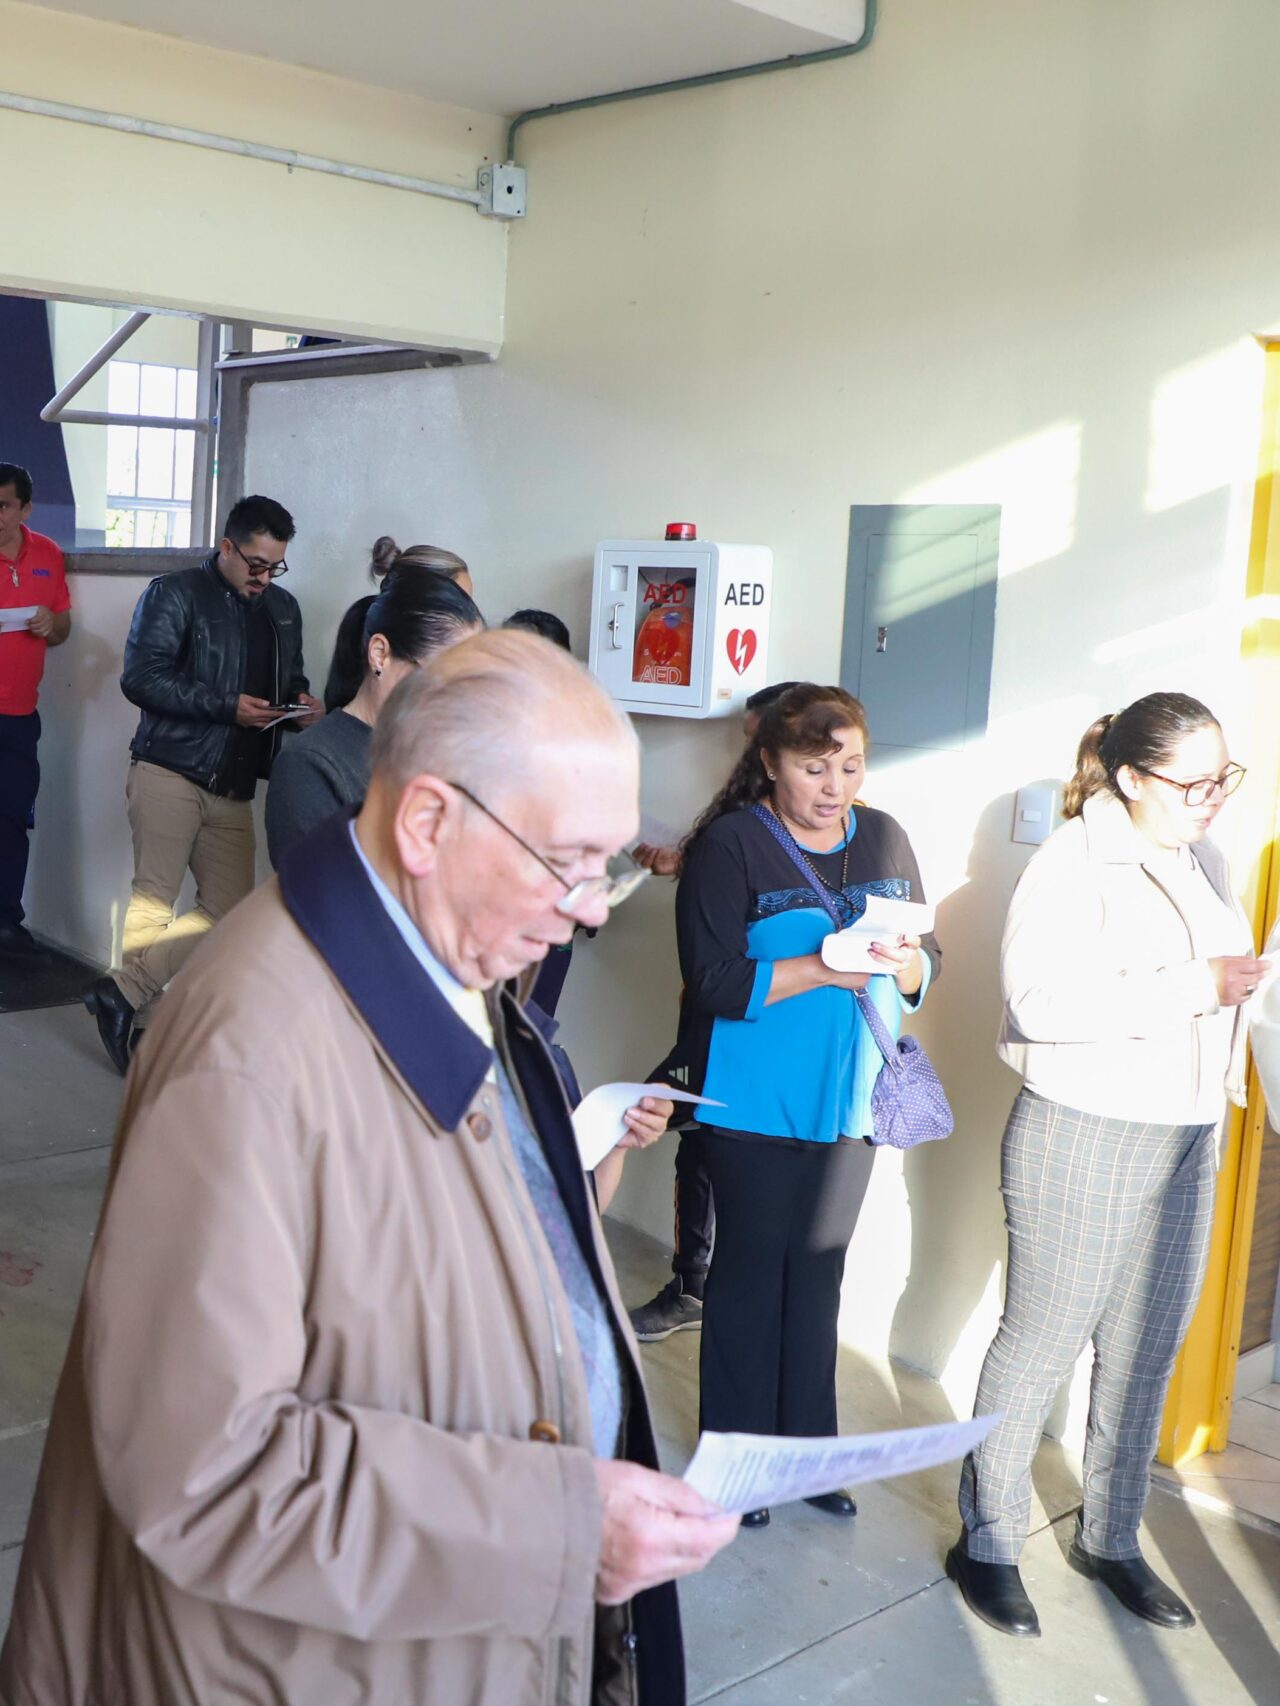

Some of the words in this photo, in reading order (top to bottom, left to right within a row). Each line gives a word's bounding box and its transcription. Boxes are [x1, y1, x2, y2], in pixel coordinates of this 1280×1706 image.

[643, 583, 687, 604] AED
[724, 583, 765, 606] AED
[639, 664, 682, 686] AED
